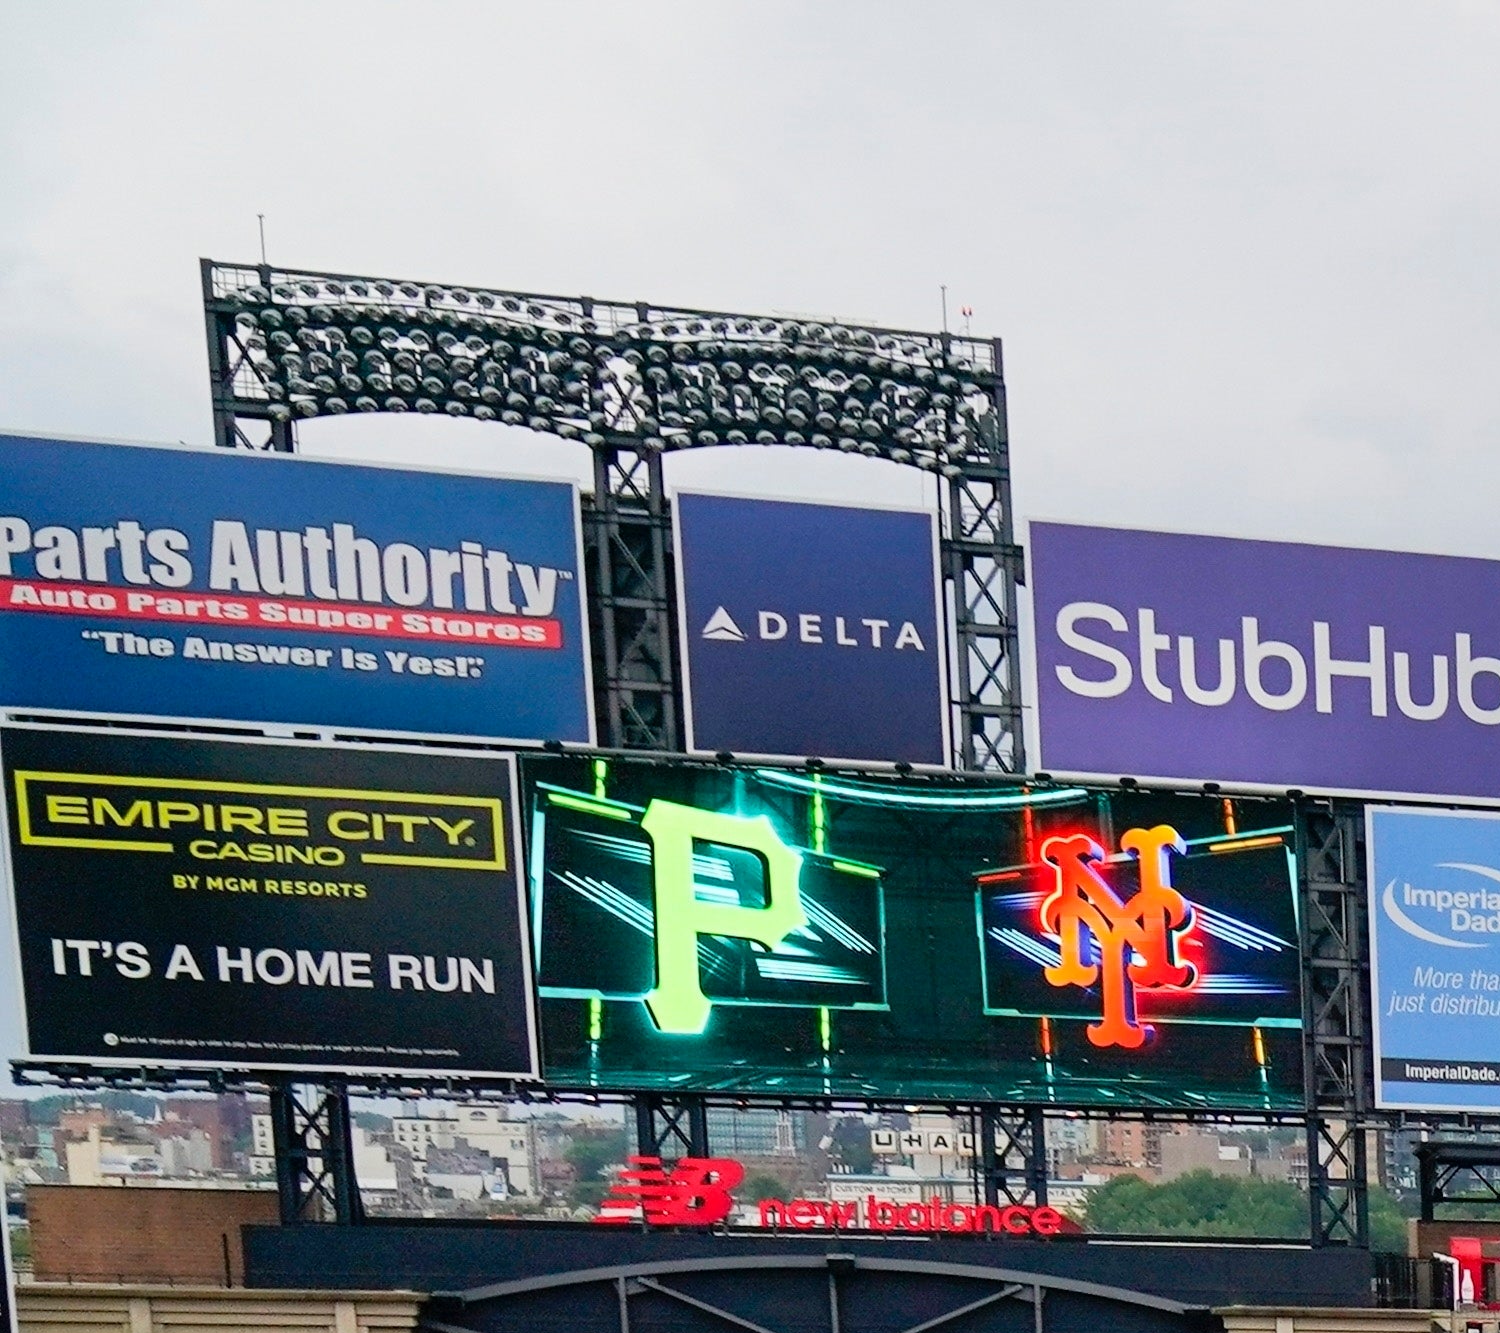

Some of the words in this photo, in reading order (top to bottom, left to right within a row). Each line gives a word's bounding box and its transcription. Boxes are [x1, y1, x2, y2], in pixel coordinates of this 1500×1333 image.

[0, 515, 193, 588] Parts
[209, 519, 557, 618] Authority
[12, 583, 118, 611] Auto
[127, 592, 249, 622] Parts
[259, 601, 394, 635] Super
[401, 612, 547, 643] Stores
[758, 611, 927, 651] DELTA
[183, 638, 332, 667] Answer
[341, 646, 380, 671] Is
[46, 795, 310, 837] EMPIRE
[327, 811, 475, 846] CITY
[188, 840, 346, 867] CASINO
[173, 875, 200, 890] BY
[206, 877, 259, 894] MGM
[264, 880, 368, 899] RESORTS
[51, 938, 152, 980] IT'S
[166, 944, 204, 982] A
[218, 945, 373, 991] HOME
[389, 953, 497, 994] RUN
[1414, 967, 1463, 989] More
[1387, 991, 1426, 1016] just
[760, 1200, 857, 1228] new
[867, 1194, 1062, 1234] balance
